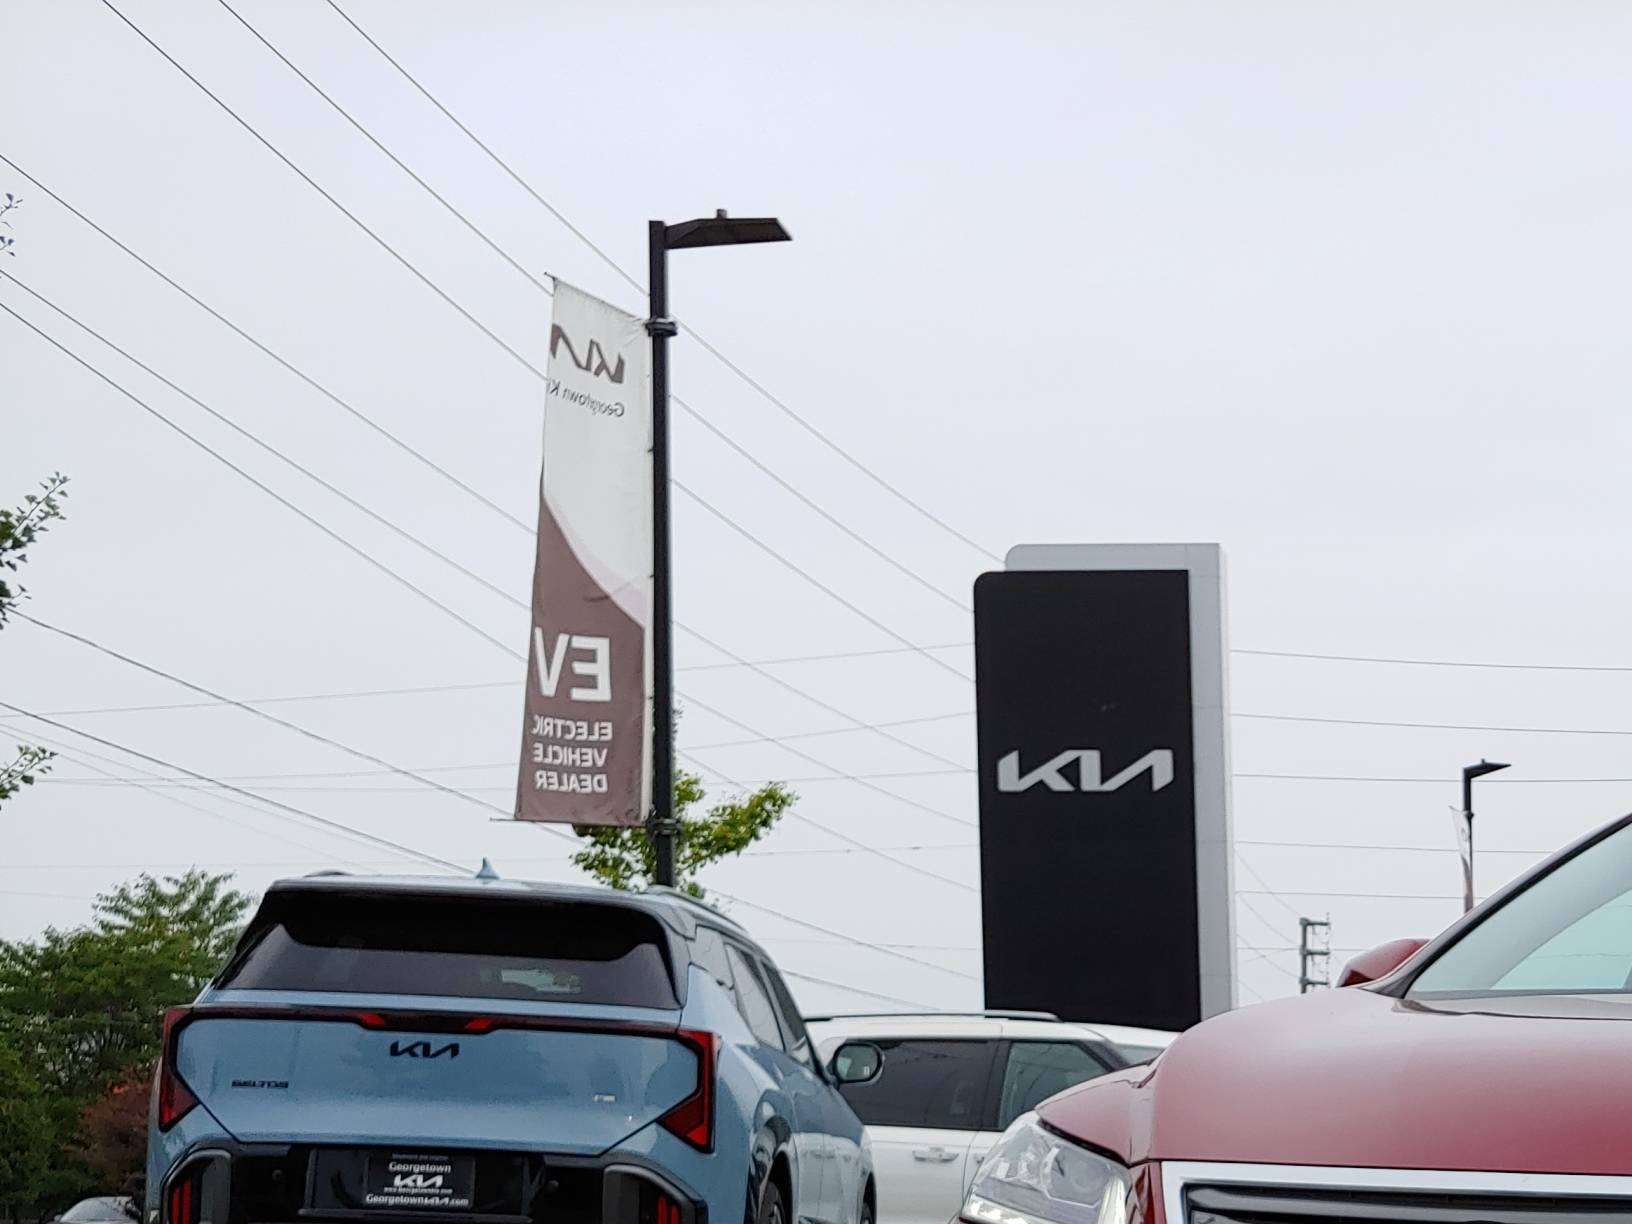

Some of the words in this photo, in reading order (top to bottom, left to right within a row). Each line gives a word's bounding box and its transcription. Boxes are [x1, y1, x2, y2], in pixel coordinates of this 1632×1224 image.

[997, 749, 1174, 792] KIA
[390, 1040, 460, 1058] KIA
[388, 1161, 452, 1173] Georgetown
[393, 1174, 444, 1188] KIA
